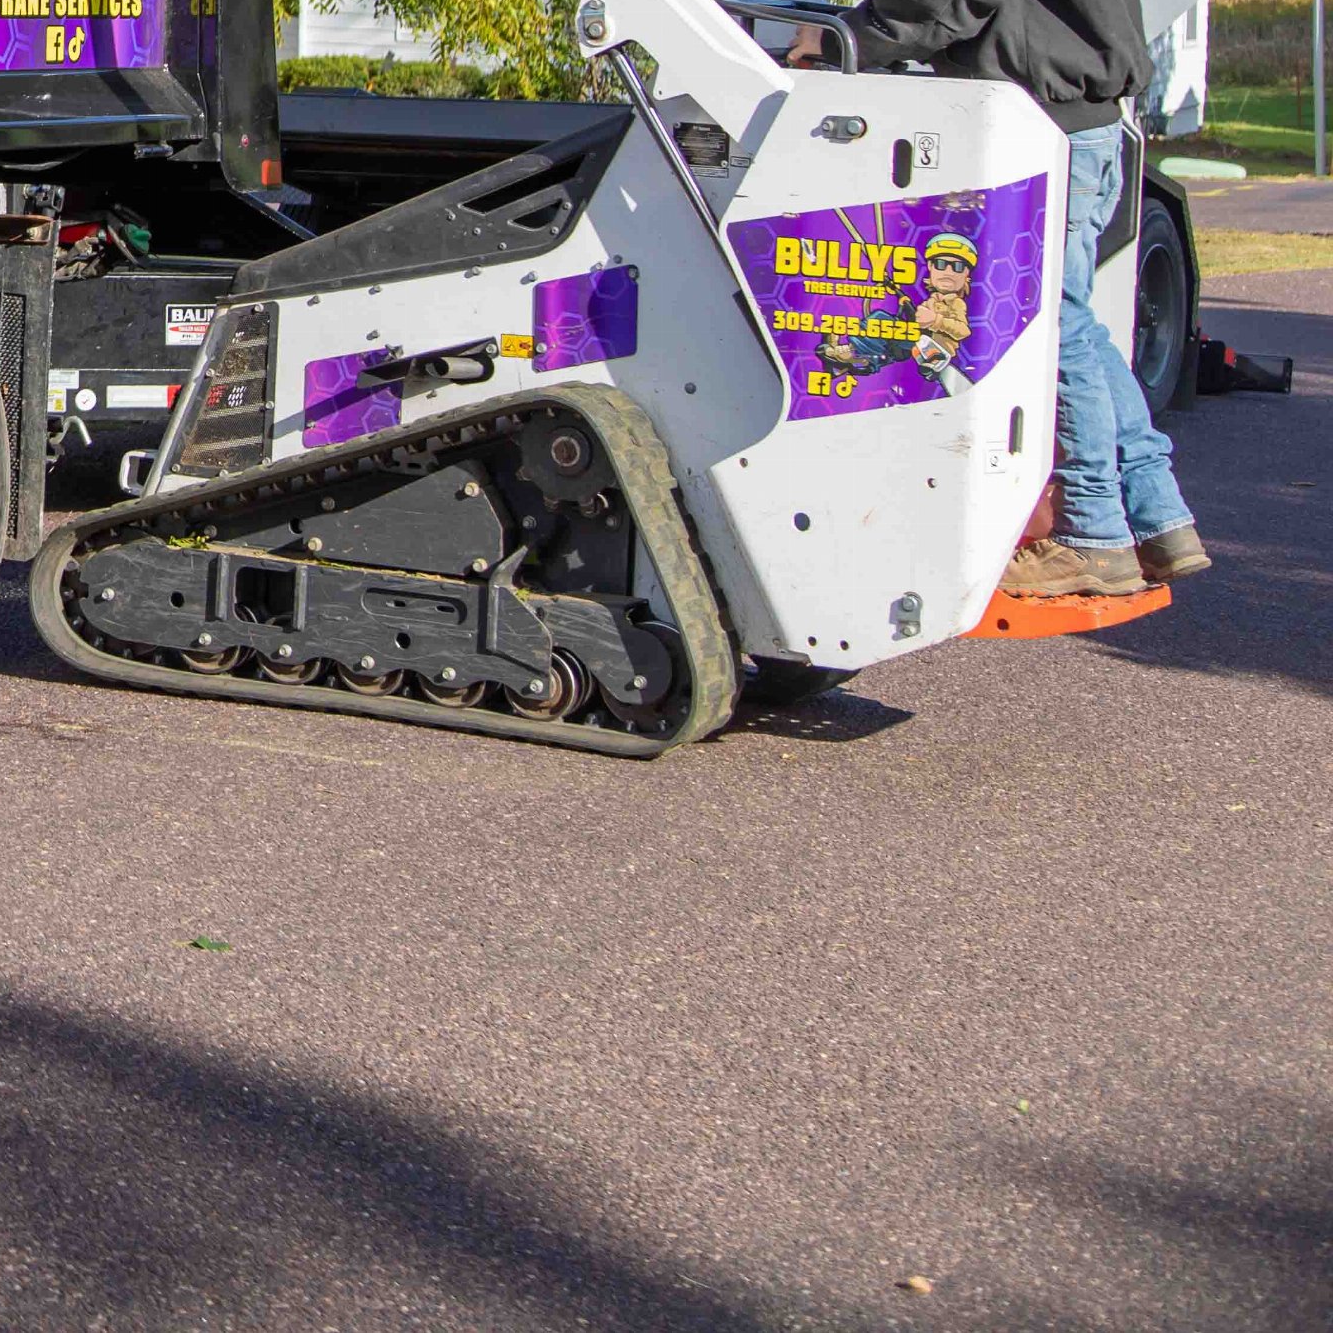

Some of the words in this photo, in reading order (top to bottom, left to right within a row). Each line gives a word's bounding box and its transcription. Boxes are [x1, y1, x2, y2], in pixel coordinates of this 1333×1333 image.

[774, 235, 917, 286] BULLYS
[803, 280, 834, 295] TREE
[835, 284, 886, 299] SERVICE
[773, 310, 921, 342] 309.265.6525
